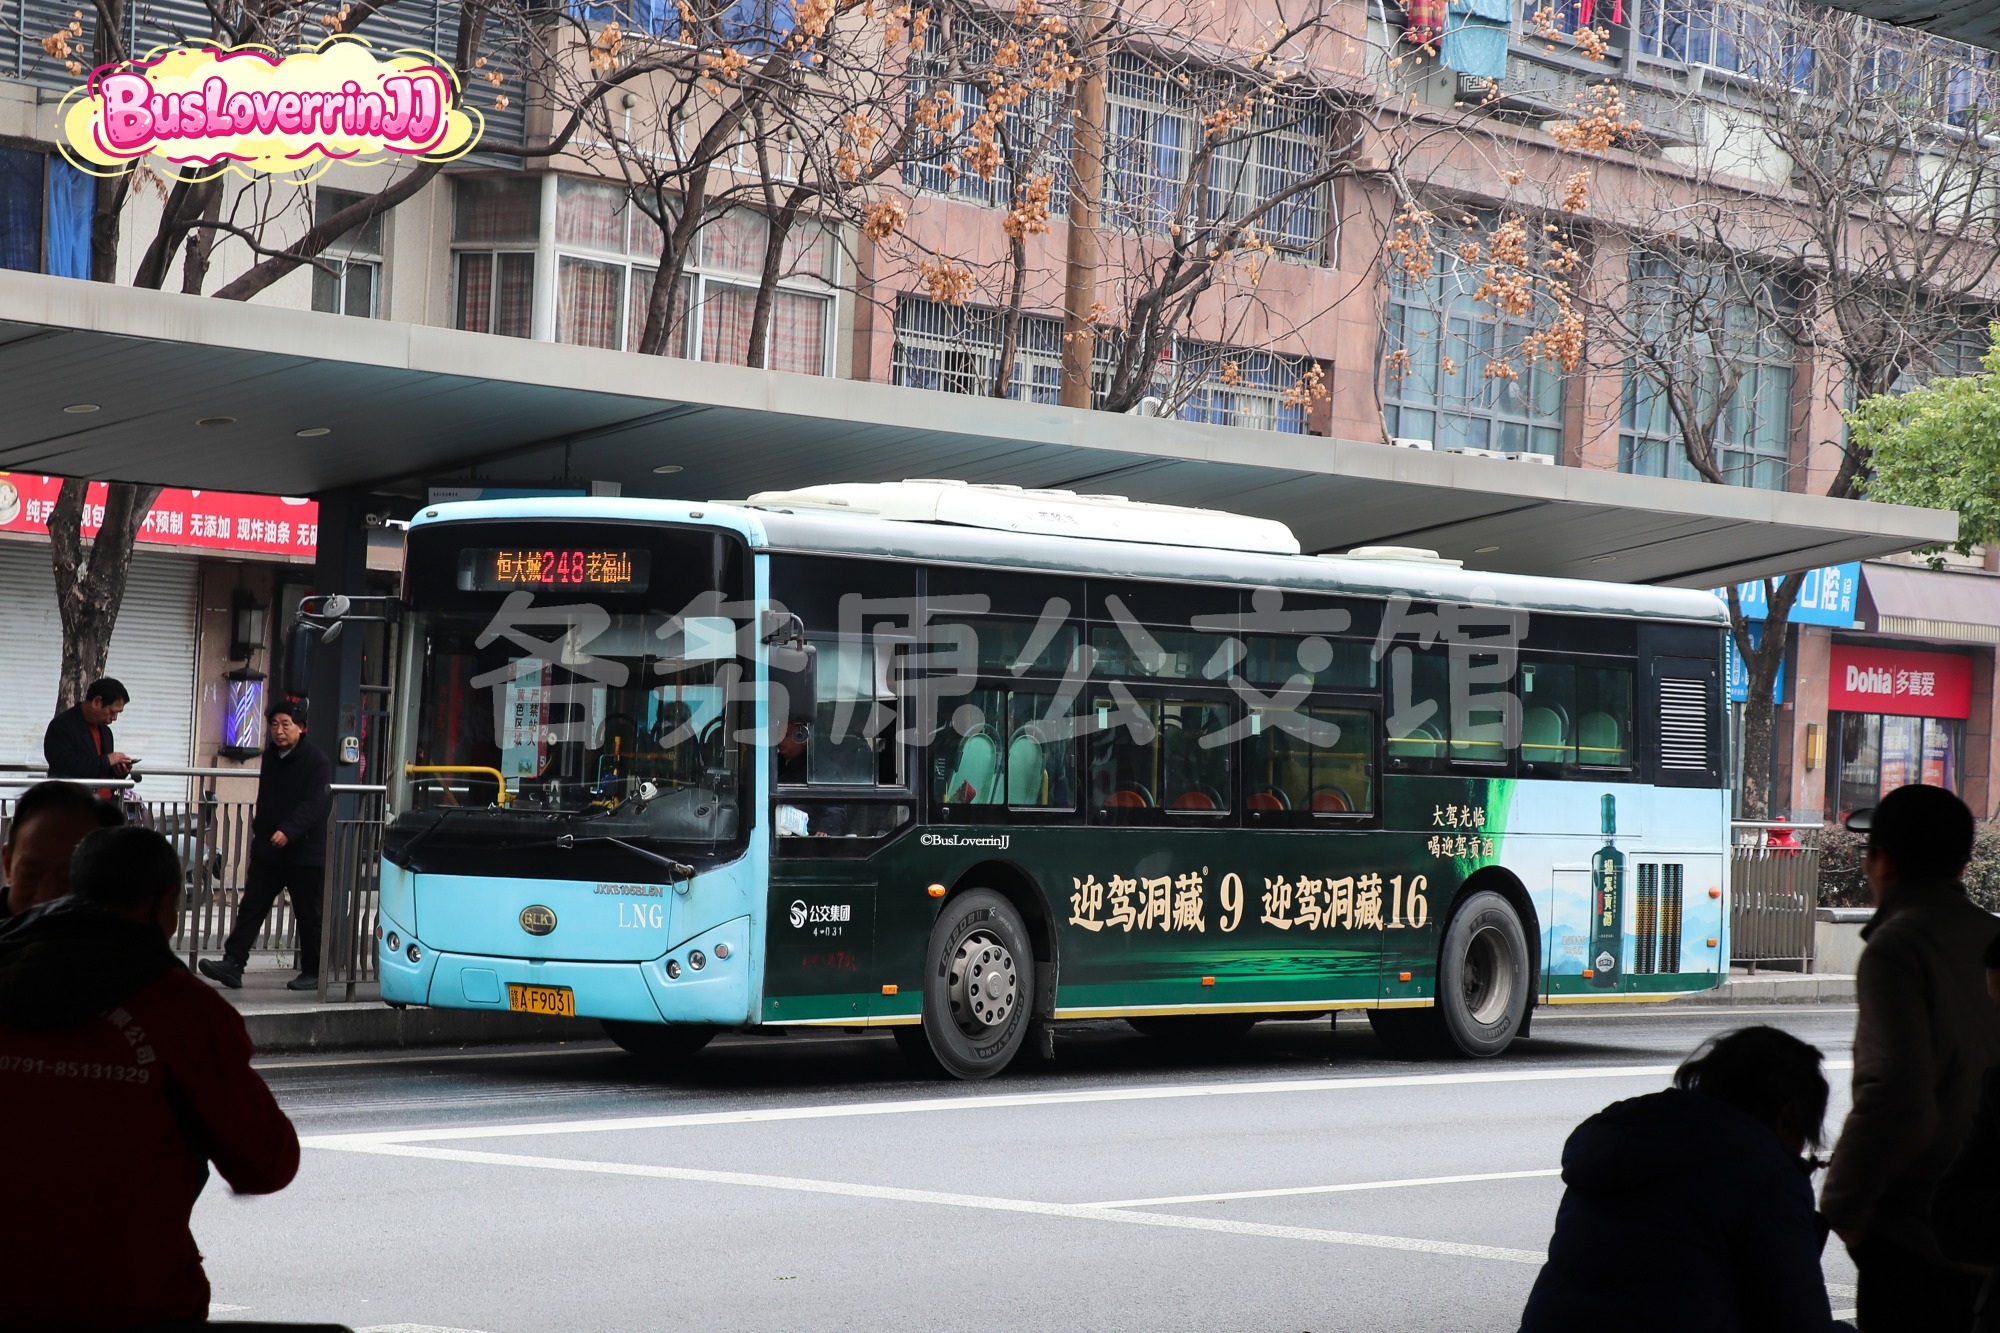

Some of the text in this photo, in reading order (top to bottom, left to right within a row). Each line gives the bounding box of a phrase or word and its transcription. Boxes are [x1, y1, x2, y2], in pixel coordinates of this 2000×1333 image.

[25, 498, 54, 525] 纯手
[142, 509, 183, 535] 不预制
[190, 512, 230, 539] 无添加
[237, 517, 290, 544] 现炸油条
[541, 552, 584, 583] 248
[1846, 664, 1935, 697] Dohia 多喜爱
[1432, 804, 1485, 828] 大驾光临
[1427, 836, 1494, 859] 喝迎驾贡酒
[618, 902, 664, 929] LNG
[809, 904, 850, 922] 公交集团
[1219, 872, 1244, 932] 9
[0, 1055, 150, 1084] 0791-85131329
